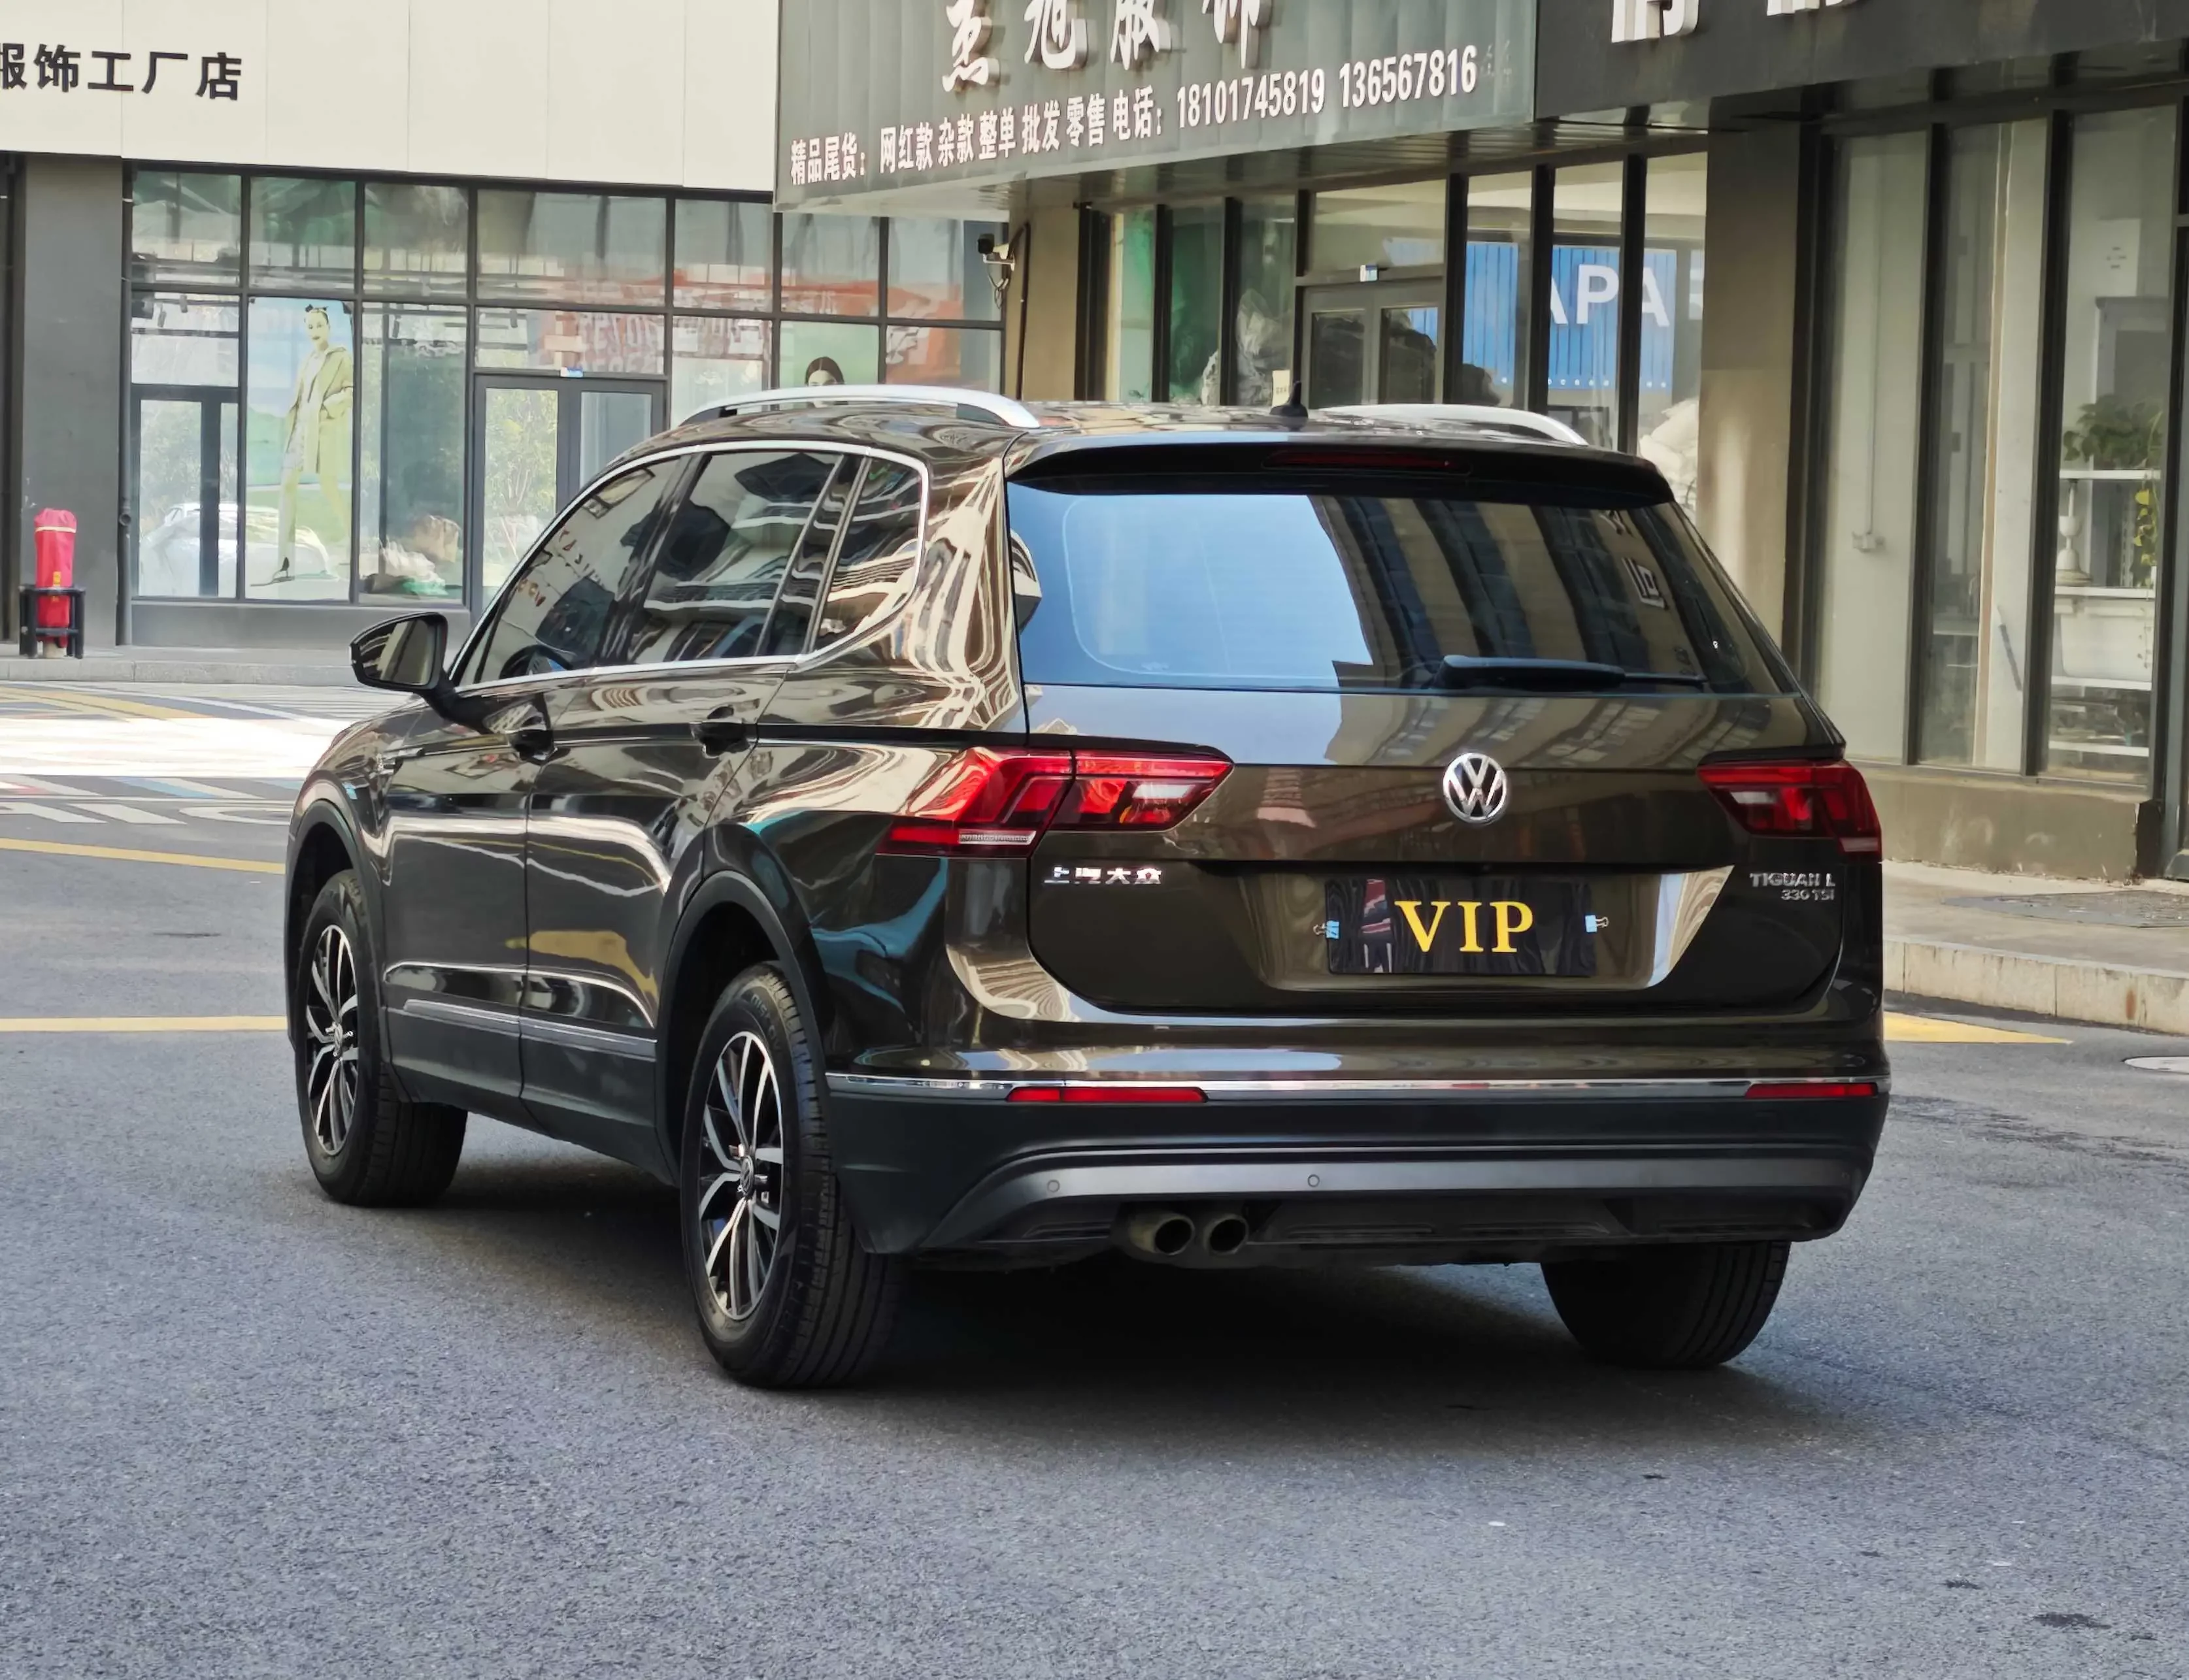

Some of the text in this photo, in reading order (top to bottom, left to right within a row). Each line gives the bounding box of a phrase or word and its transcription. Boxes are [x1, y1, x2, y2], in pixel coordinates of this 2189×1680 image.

[0, 43, 242, 100] 服饰工厂店
[880, 122, 933, 173] 网红款
[938, 113, 975, 167] 杂款
[979, 105, 1016, 160] 整单
[1022, 99, 1060, 154] 批发
[1066, 93, 1106, 147] 零售
[1177, 68, 1326, 129] 18101745819
[1394, 900, 1533, 953] VIP
